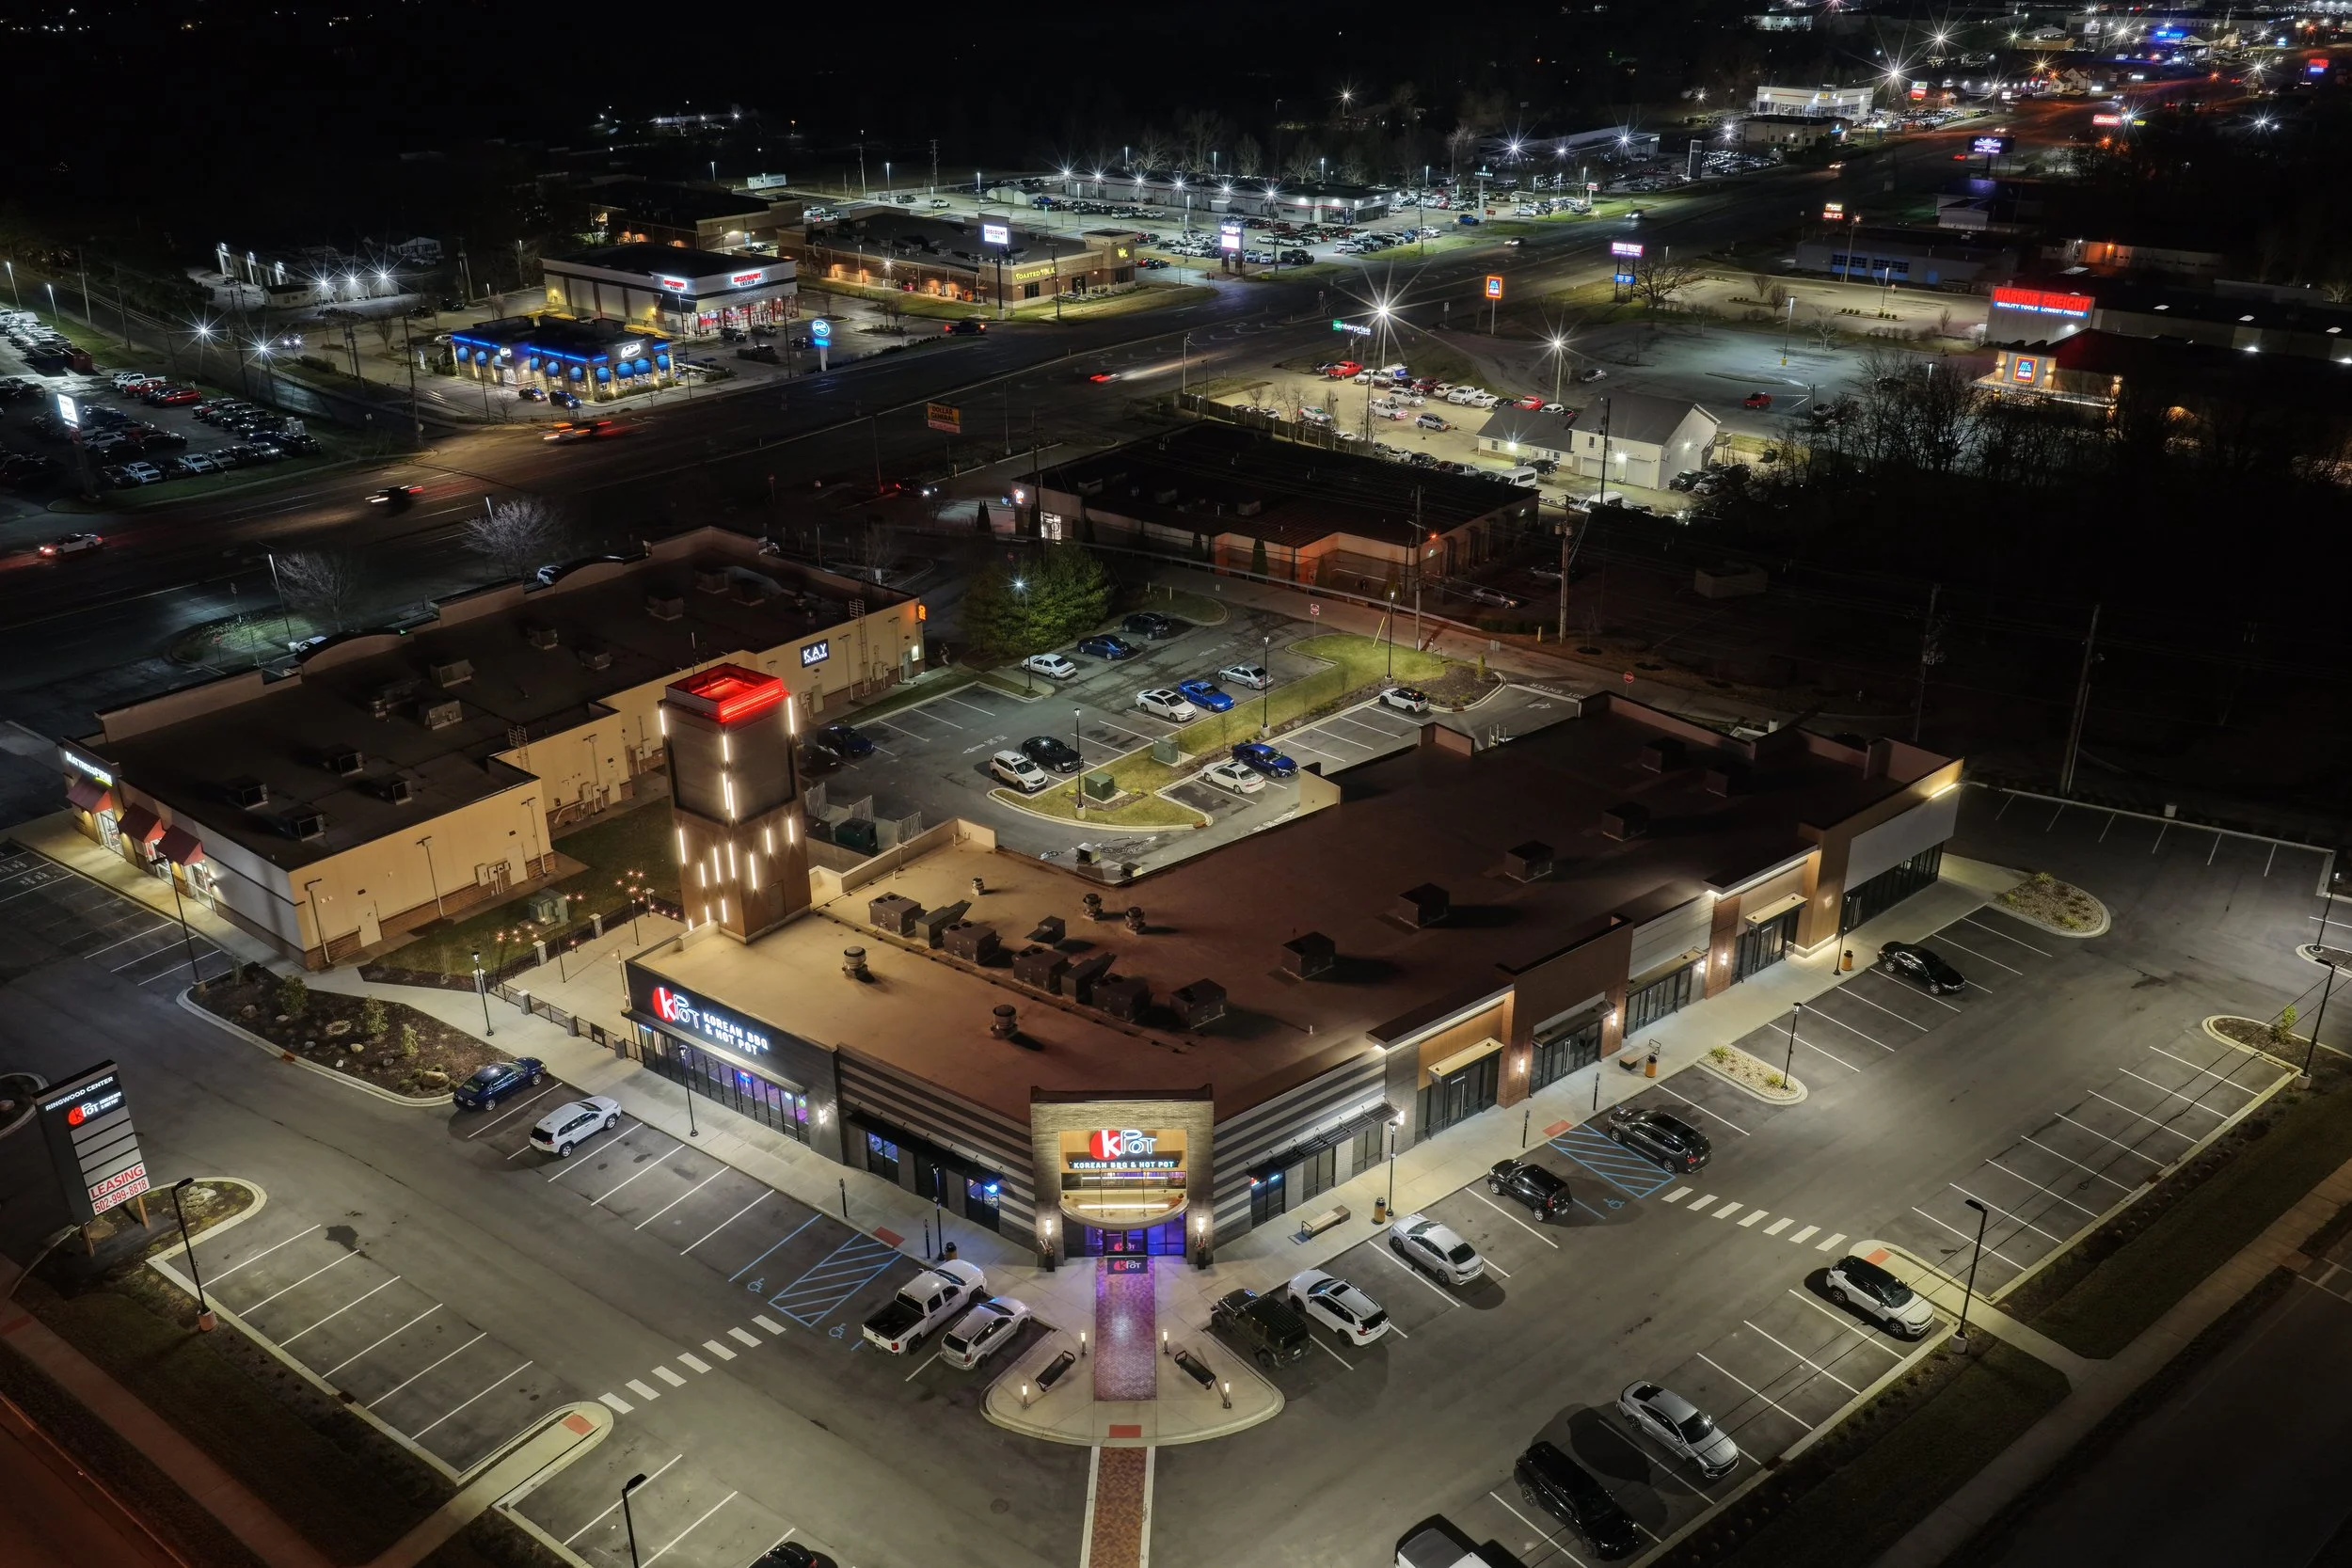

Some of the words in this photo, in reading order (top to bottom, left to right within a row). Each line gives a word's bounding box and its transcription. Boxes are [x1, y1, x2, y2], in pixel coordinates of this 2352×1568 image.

[1015, 269, 1041, 280] TOASTED
[1994, 288, 2040, 306] HARBOR
[2042, 293, 2091, 311] FREIGHT
[2041, 306, 2064, 314] LOWEST
[1334, 323, 1371, 333] enterprise
[930, 412, 954, 422] GENERAL
[931, 405, 953, 416] DOLLAR
[803, 643, 826, 659] KAY
[703, 1012, 743, 1038] KOREAN
[746, 1031, 770, 1051] BBQ
[704, 1023, 713, 1036] &
[716, 1028, 735, 1045] HOT
[738, 1038, 758, 1055] POT
[45, 1088, 86, 1112] RINGWOOD
[86, 1076, 114, 1092] CENTER
[89, 1164, 143, 1199] LEASING
[95, 1179, 148, 1213] 502-999-8818
